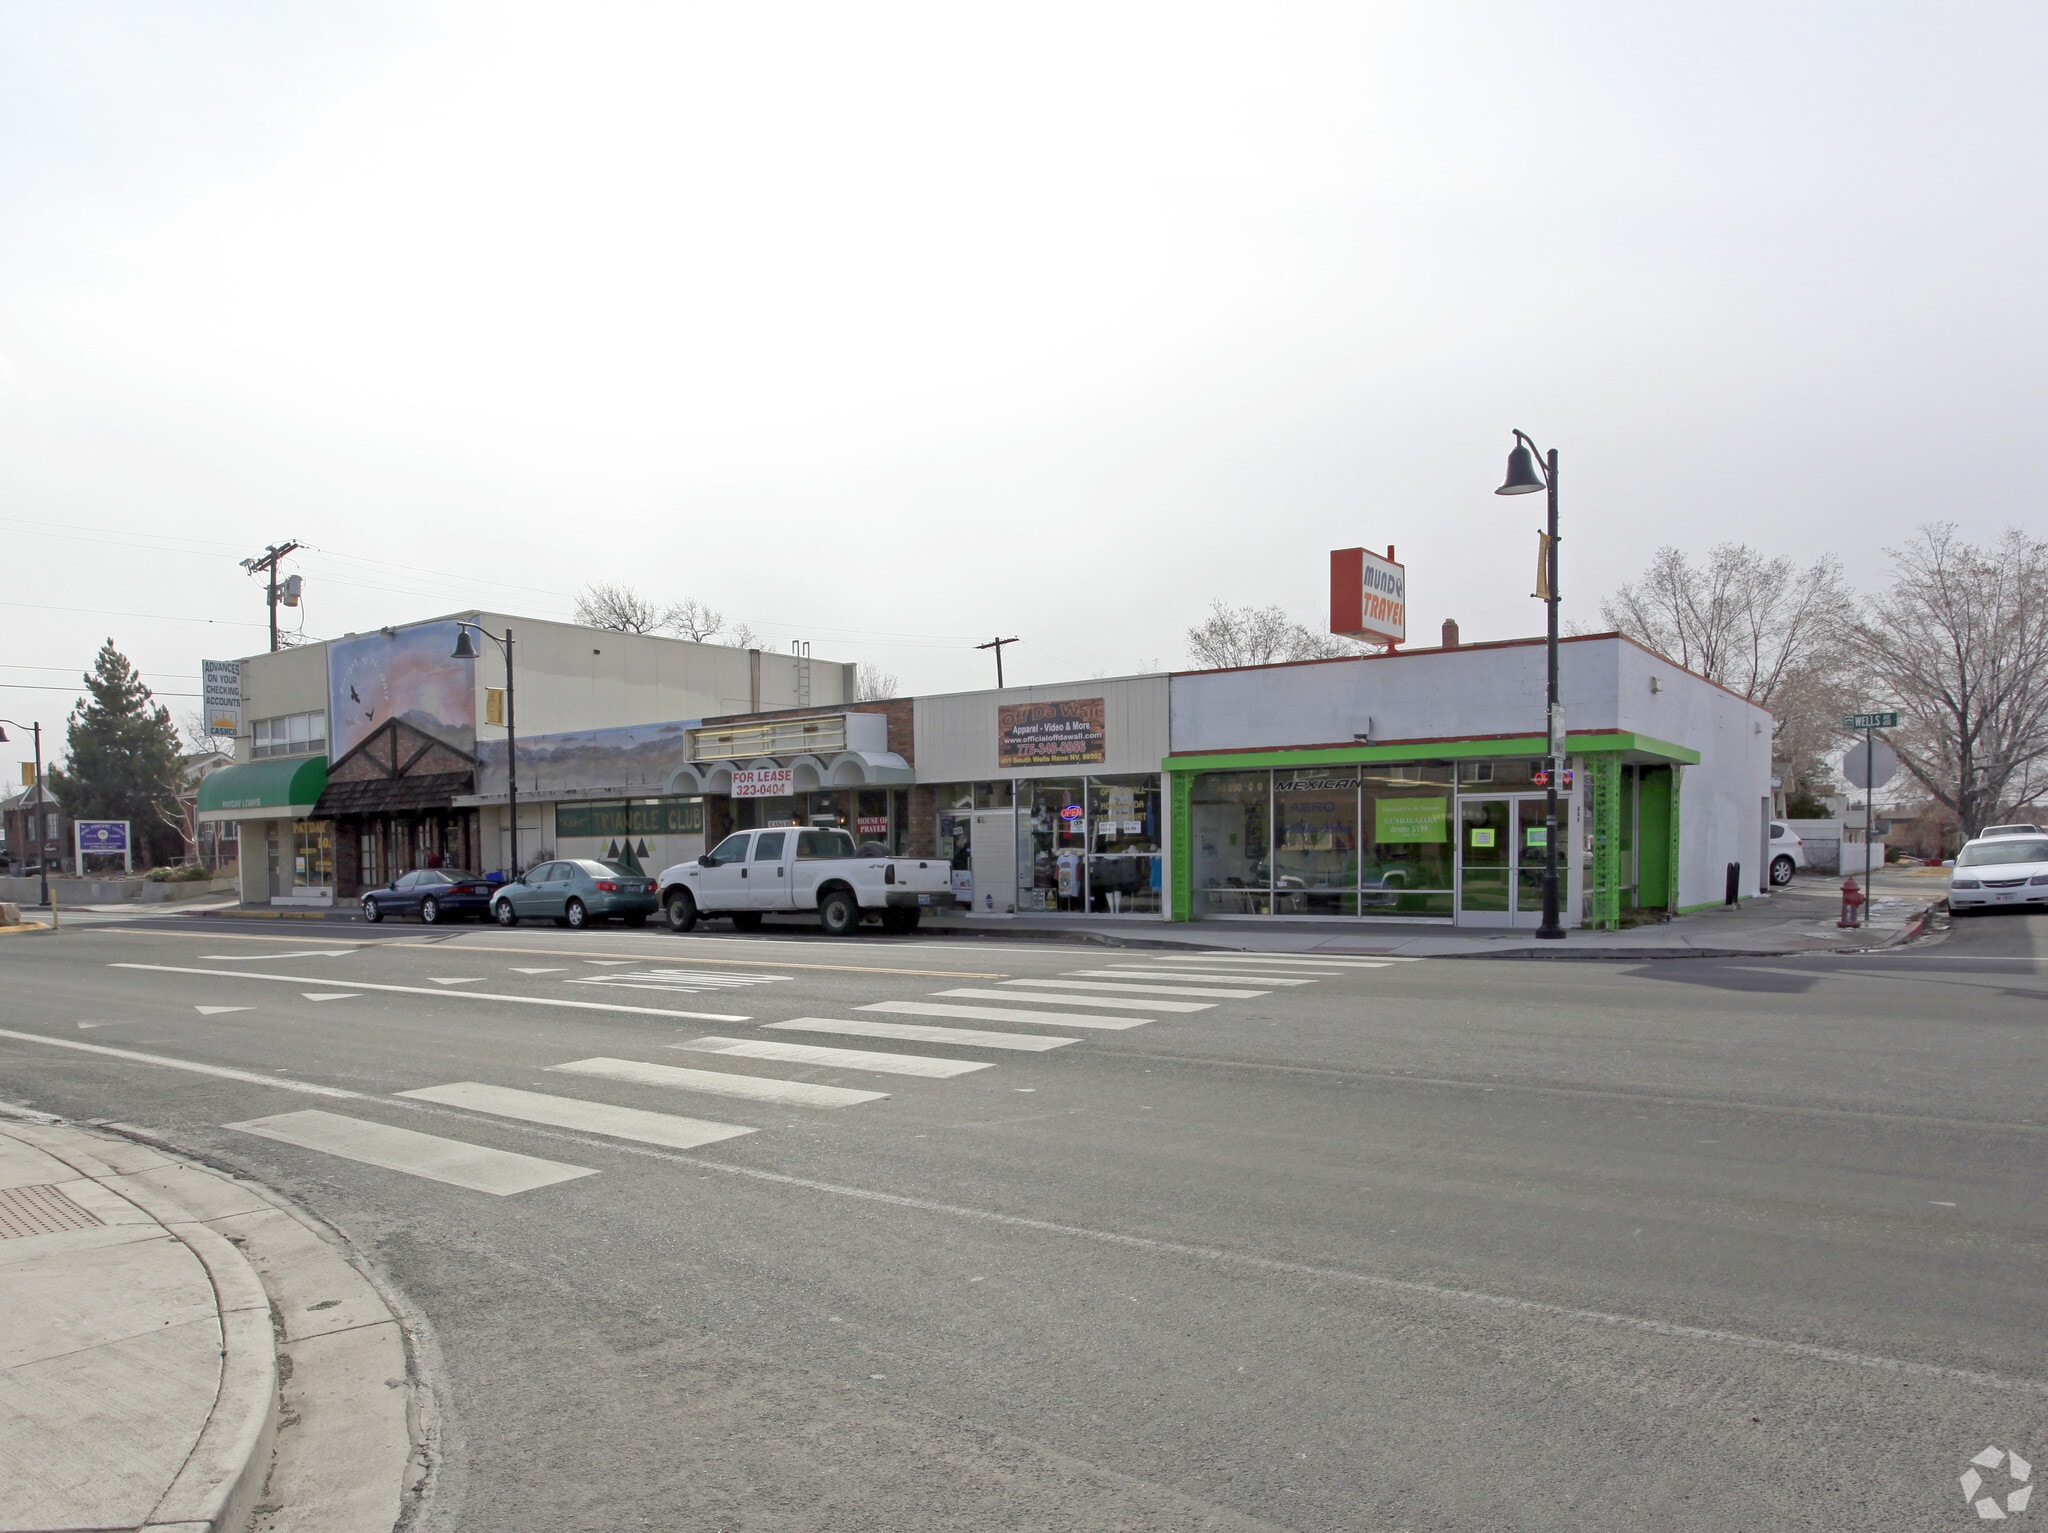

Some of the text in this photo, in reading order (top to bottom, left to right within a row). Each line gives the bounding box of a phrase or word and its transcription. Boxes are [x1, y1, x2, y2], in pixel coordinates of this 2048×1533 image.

[1364, 565, 1403, 598] MUNDO
[1364, 592, 1404, 626] TRAVEL
[205, 661, 240, 676] ADVANCES
[207, 673, 238, 684] ON YOUR
[206, 685, 240, 696] CHECKING
[206, 696, 241, 707] ACCOUNTS
[1032, 706, 1057, 721] Da
[1855, 715, 1880, 726] WELLS
[210, 727, 237, 736] CASHCO
[1012, 724, 1039, 736] Apparel
[1044, 722, 1064, 732] Video
[1065, 722, 1071, 731] &
[1072, 721, 1090, 730] More
[1004, 733, 1102, 744] www.officialoffdawall.com
[1032, 755, 1050, 763] Wells
[733, 770, 792, 783] FOR LEASE
[736, 783, 785, 796] 323-0404
[1275, 778, 1361, 791] MEXICAN
[222, 798, 261, 808] PAYDAY LOANS
[1290, 801, 1336, 813] AERO
[1061, 807, 1083, 817] OPEN
[668, 807, 702, 829] CLUB
[857, 817, 879, 825] HOUSE
[860, 825, 887, 833] PRAYER
